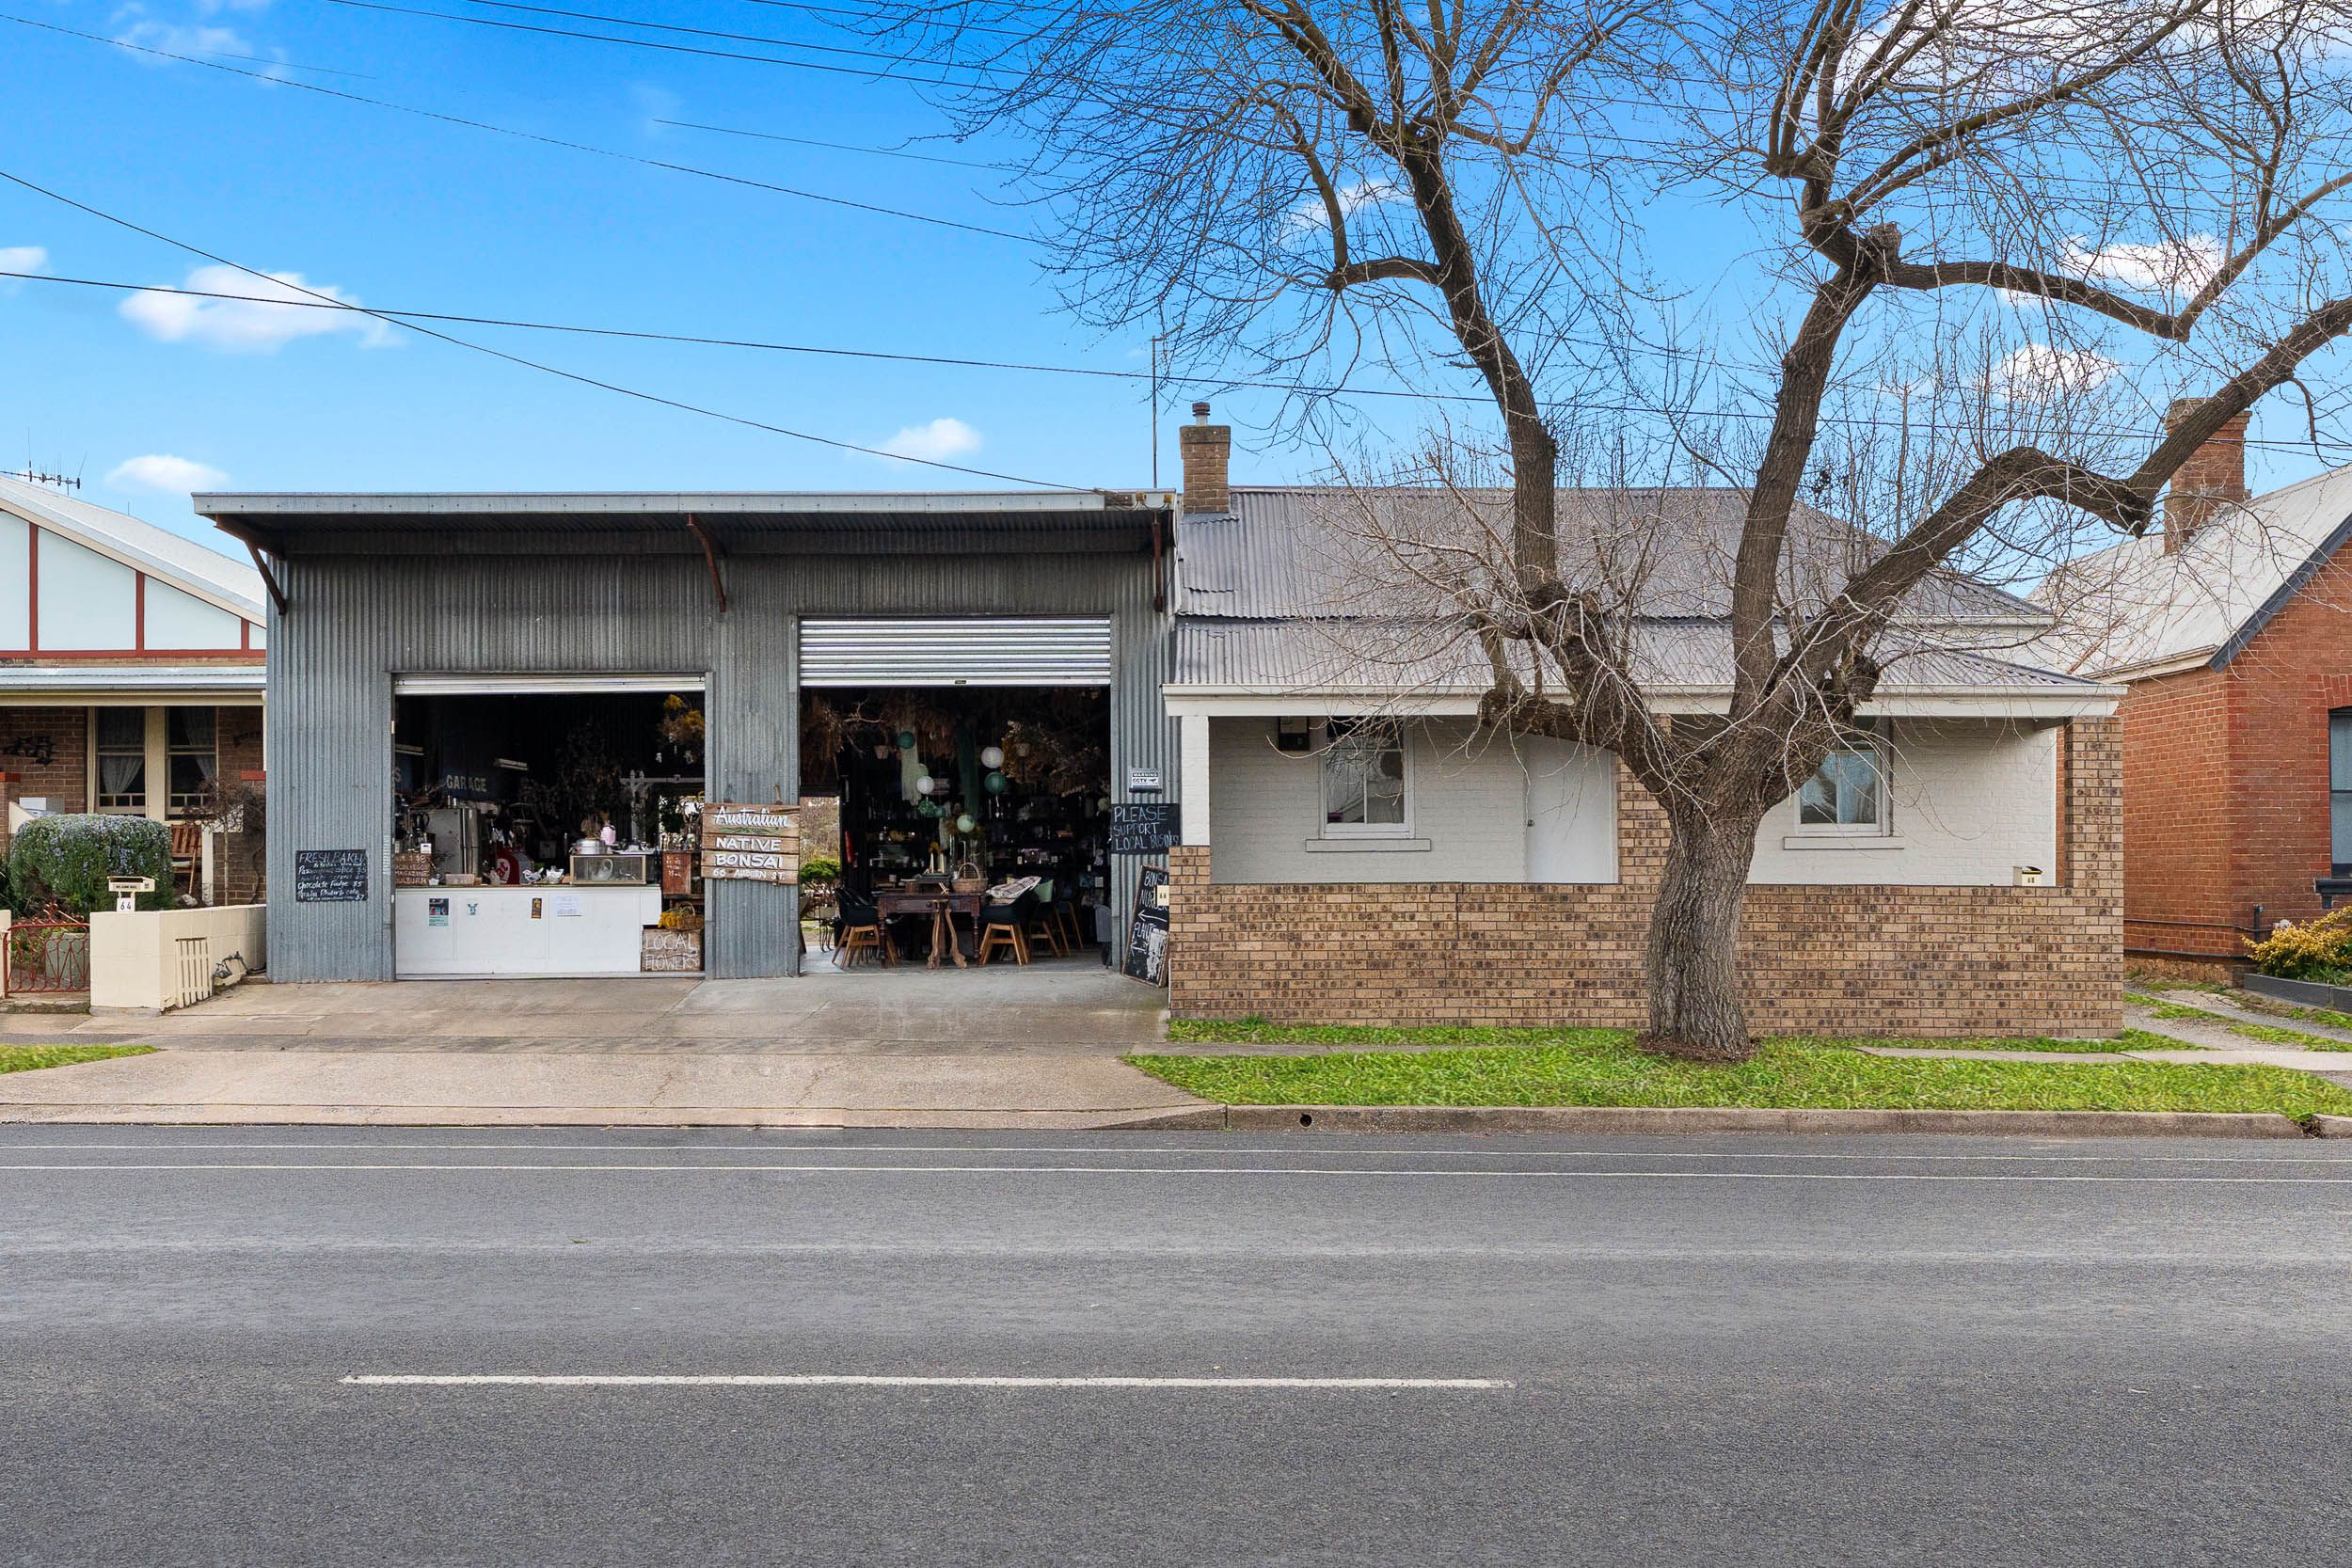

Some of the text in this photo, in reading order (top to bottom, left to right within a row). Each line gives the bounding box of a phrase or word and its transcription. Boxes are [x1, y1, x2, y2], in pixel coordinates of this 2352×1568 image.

[446, 774, 487, 792] GARAGE
[714, 806, 788, 828] Australian
[1114, 806, 1168, 822] PLEASE
[1113, 822, 1160, 836] SUPPORT
[716, 837, 782, 851] NATIVE
[1116, 836, 1148, 850] LOCAL
[299, 852, 330, 863] FRESH
[715, 853, 784, 868] BONSAI
[712, 868, 726, 877] 66
[734, 869, 767, 879] AUBURN
[119, 901, 132, 911] 64
[645, 932, 700, 950] LOCAL
